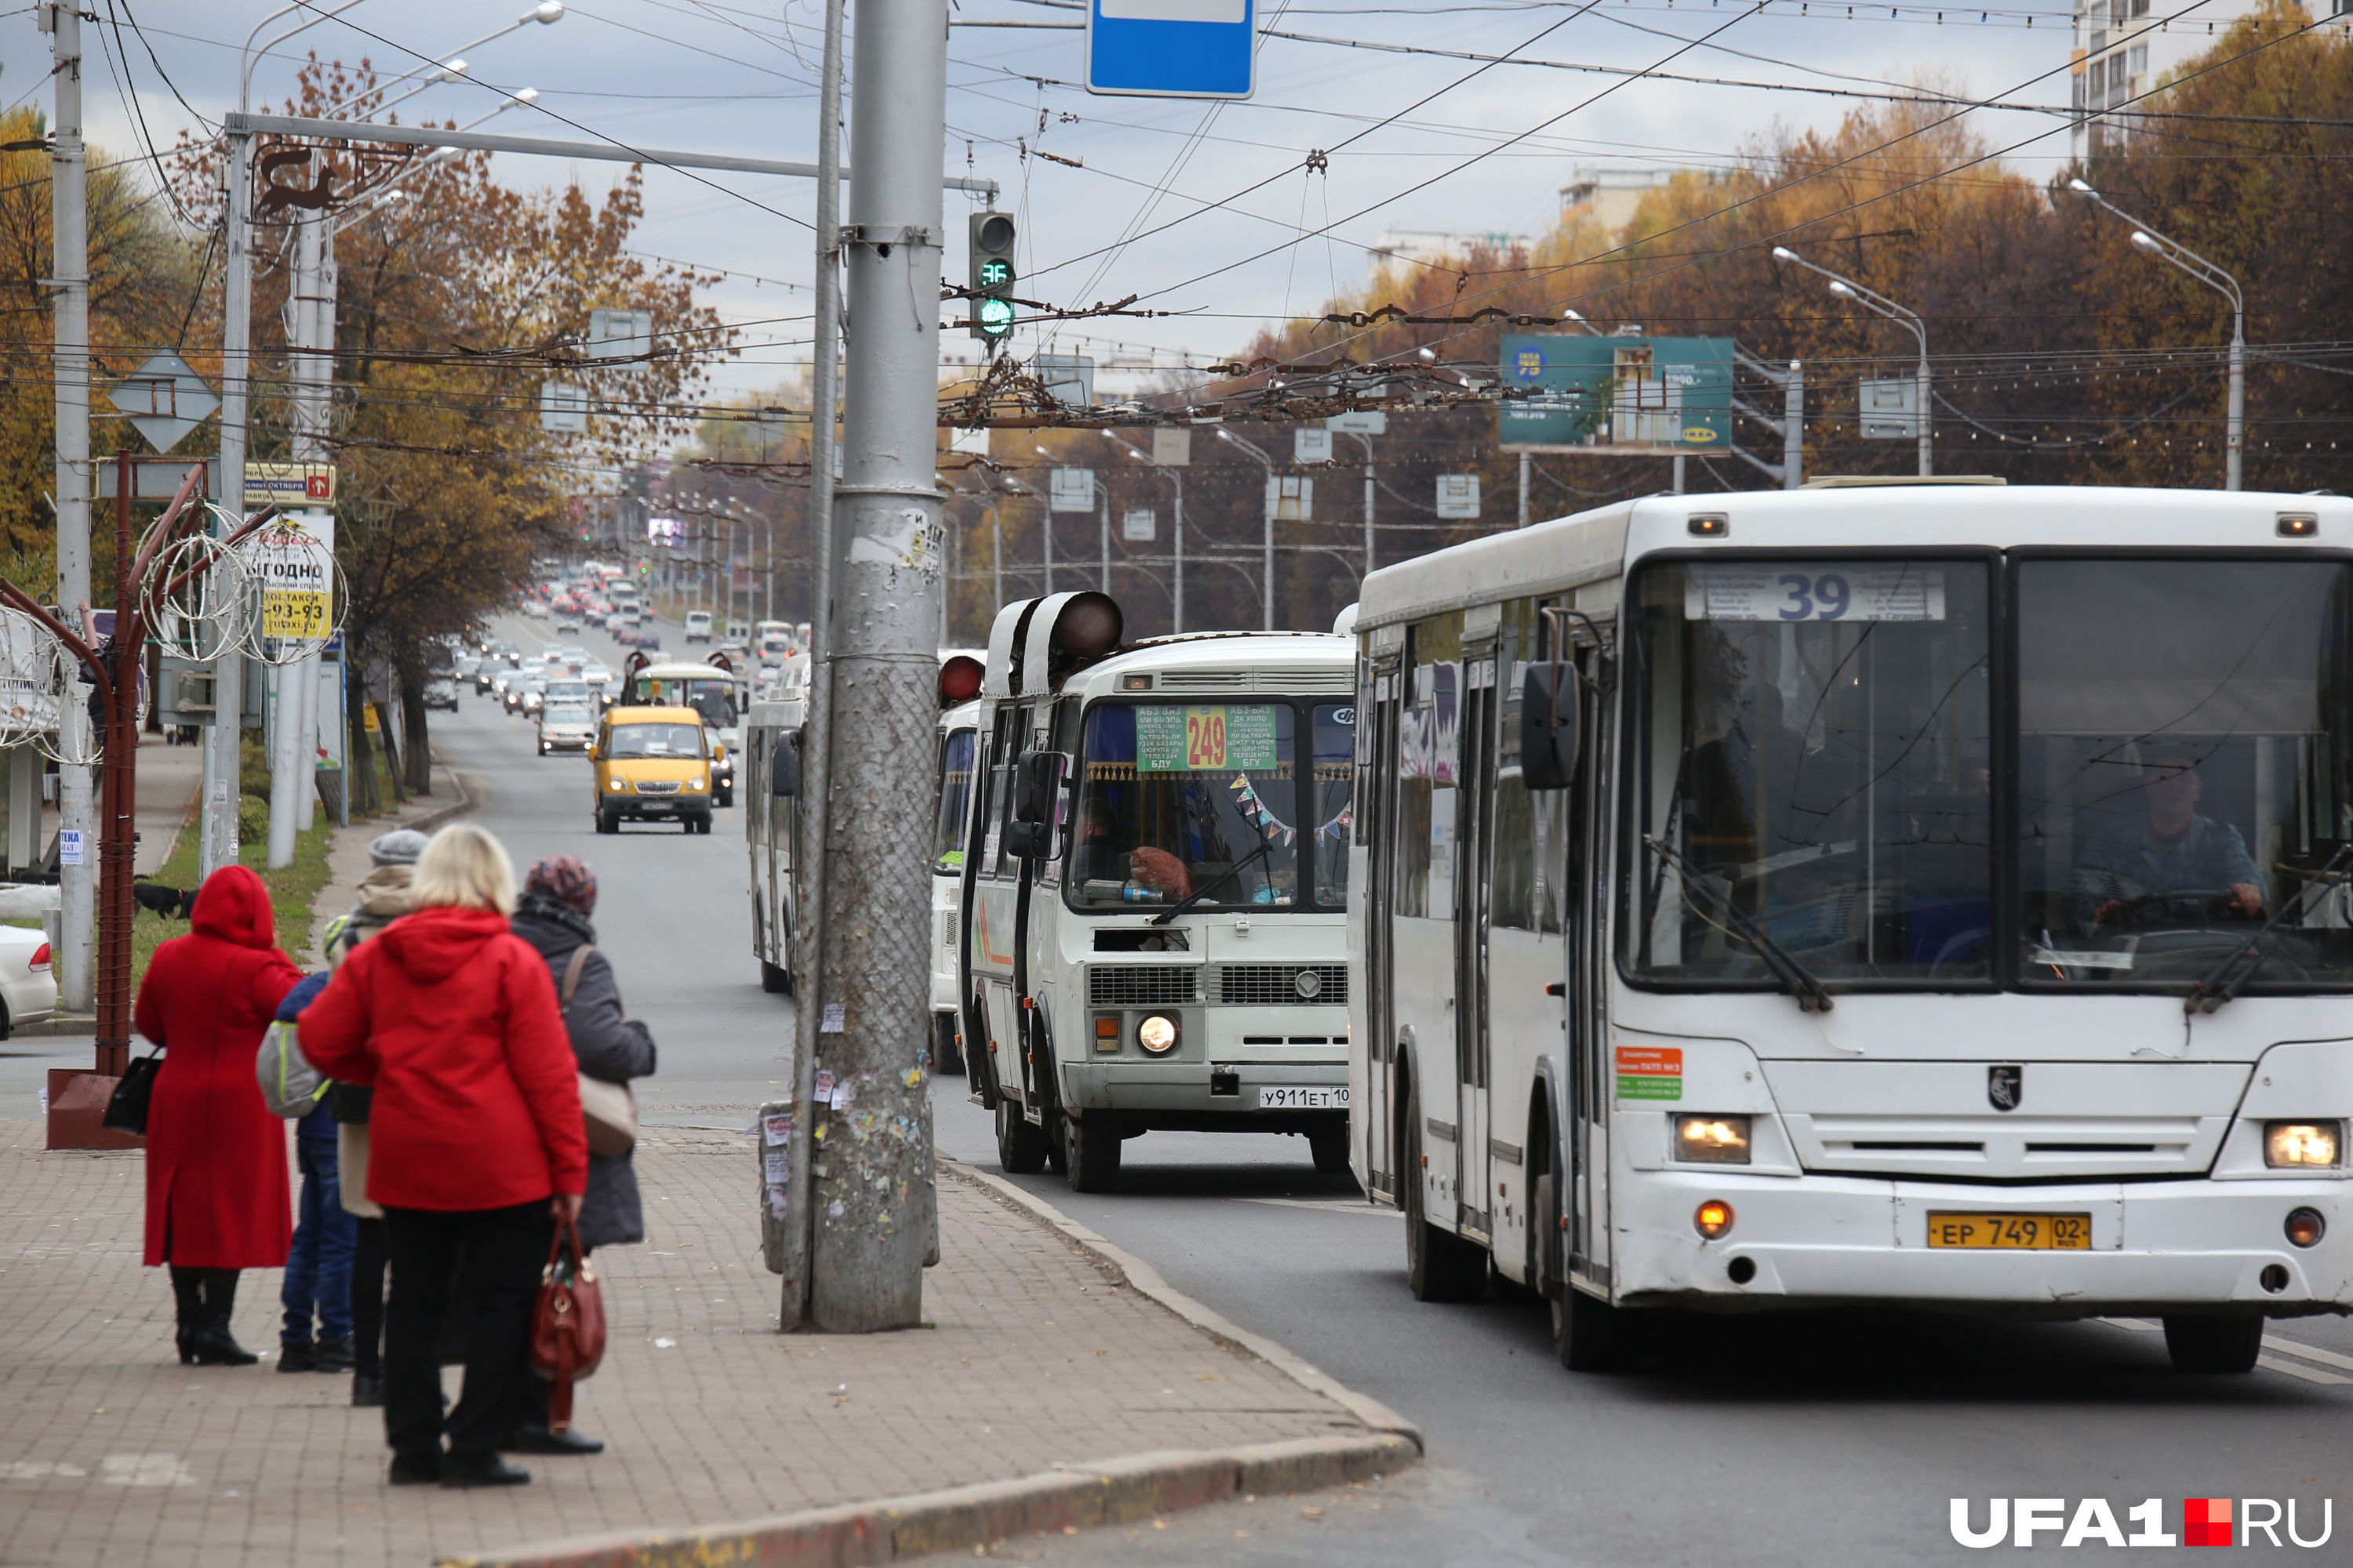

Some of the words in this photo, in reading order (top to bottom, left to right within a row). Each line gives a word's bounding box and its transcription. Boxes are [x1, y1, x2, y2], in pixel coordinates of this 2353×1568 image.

[1778, 574, 1851, 620] 39
[1188, 716, 1225, 766] 249
[1151, 760, 1172, 769] БДУ
[1242, 759, 1260, 767] БГУ
[1942, 1224, 1975, 1245] ЕР
[1988, 1219, 2038, 1246] 749
[2054, 1219, 2080, 1239] 02
